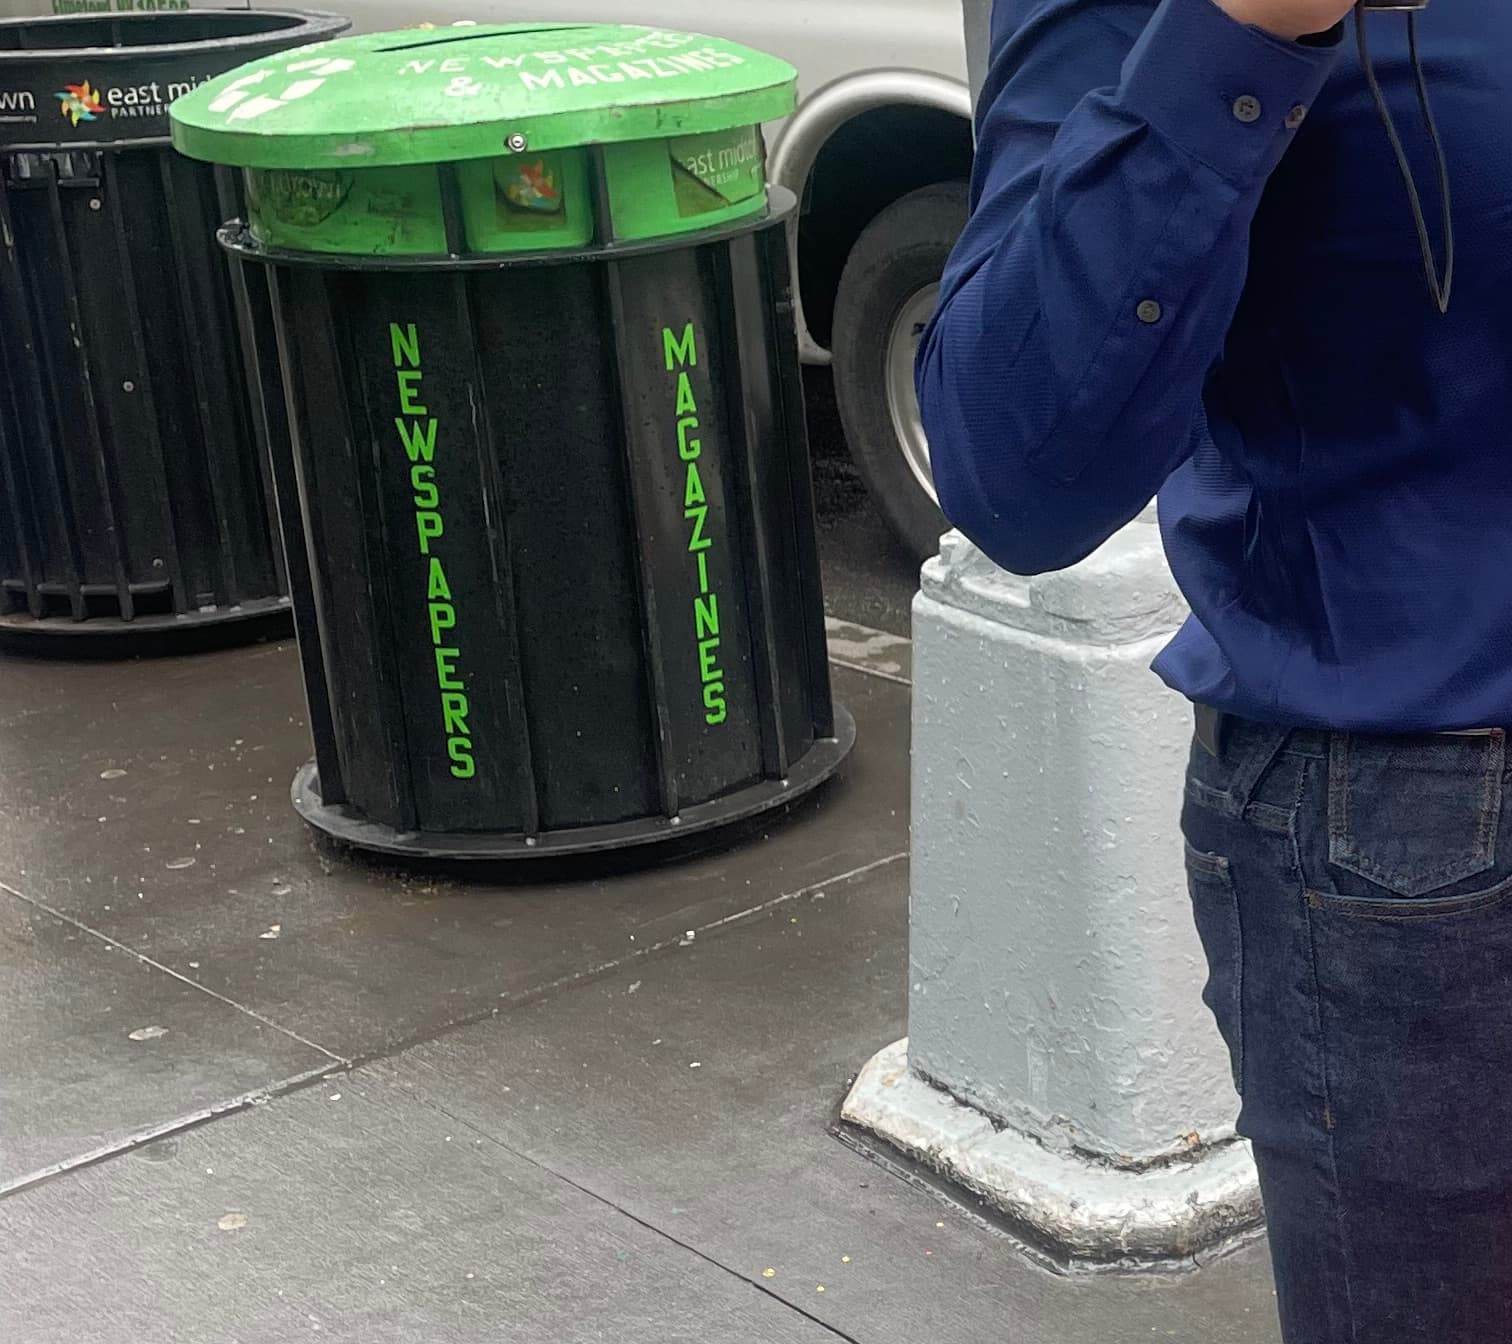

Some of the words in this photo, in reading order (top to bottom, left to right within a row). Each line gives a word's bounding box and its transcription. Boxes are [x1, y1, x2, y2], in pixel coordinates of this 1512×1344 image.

[107, 82, 162, 105] east
[444, 76, 482, 97] &
[517, 47, 745, 91] MAGAZINES
[389, 322, 475, 779] NEWSPAPERS
[662, 322, 727, 725] MAGAZINES
